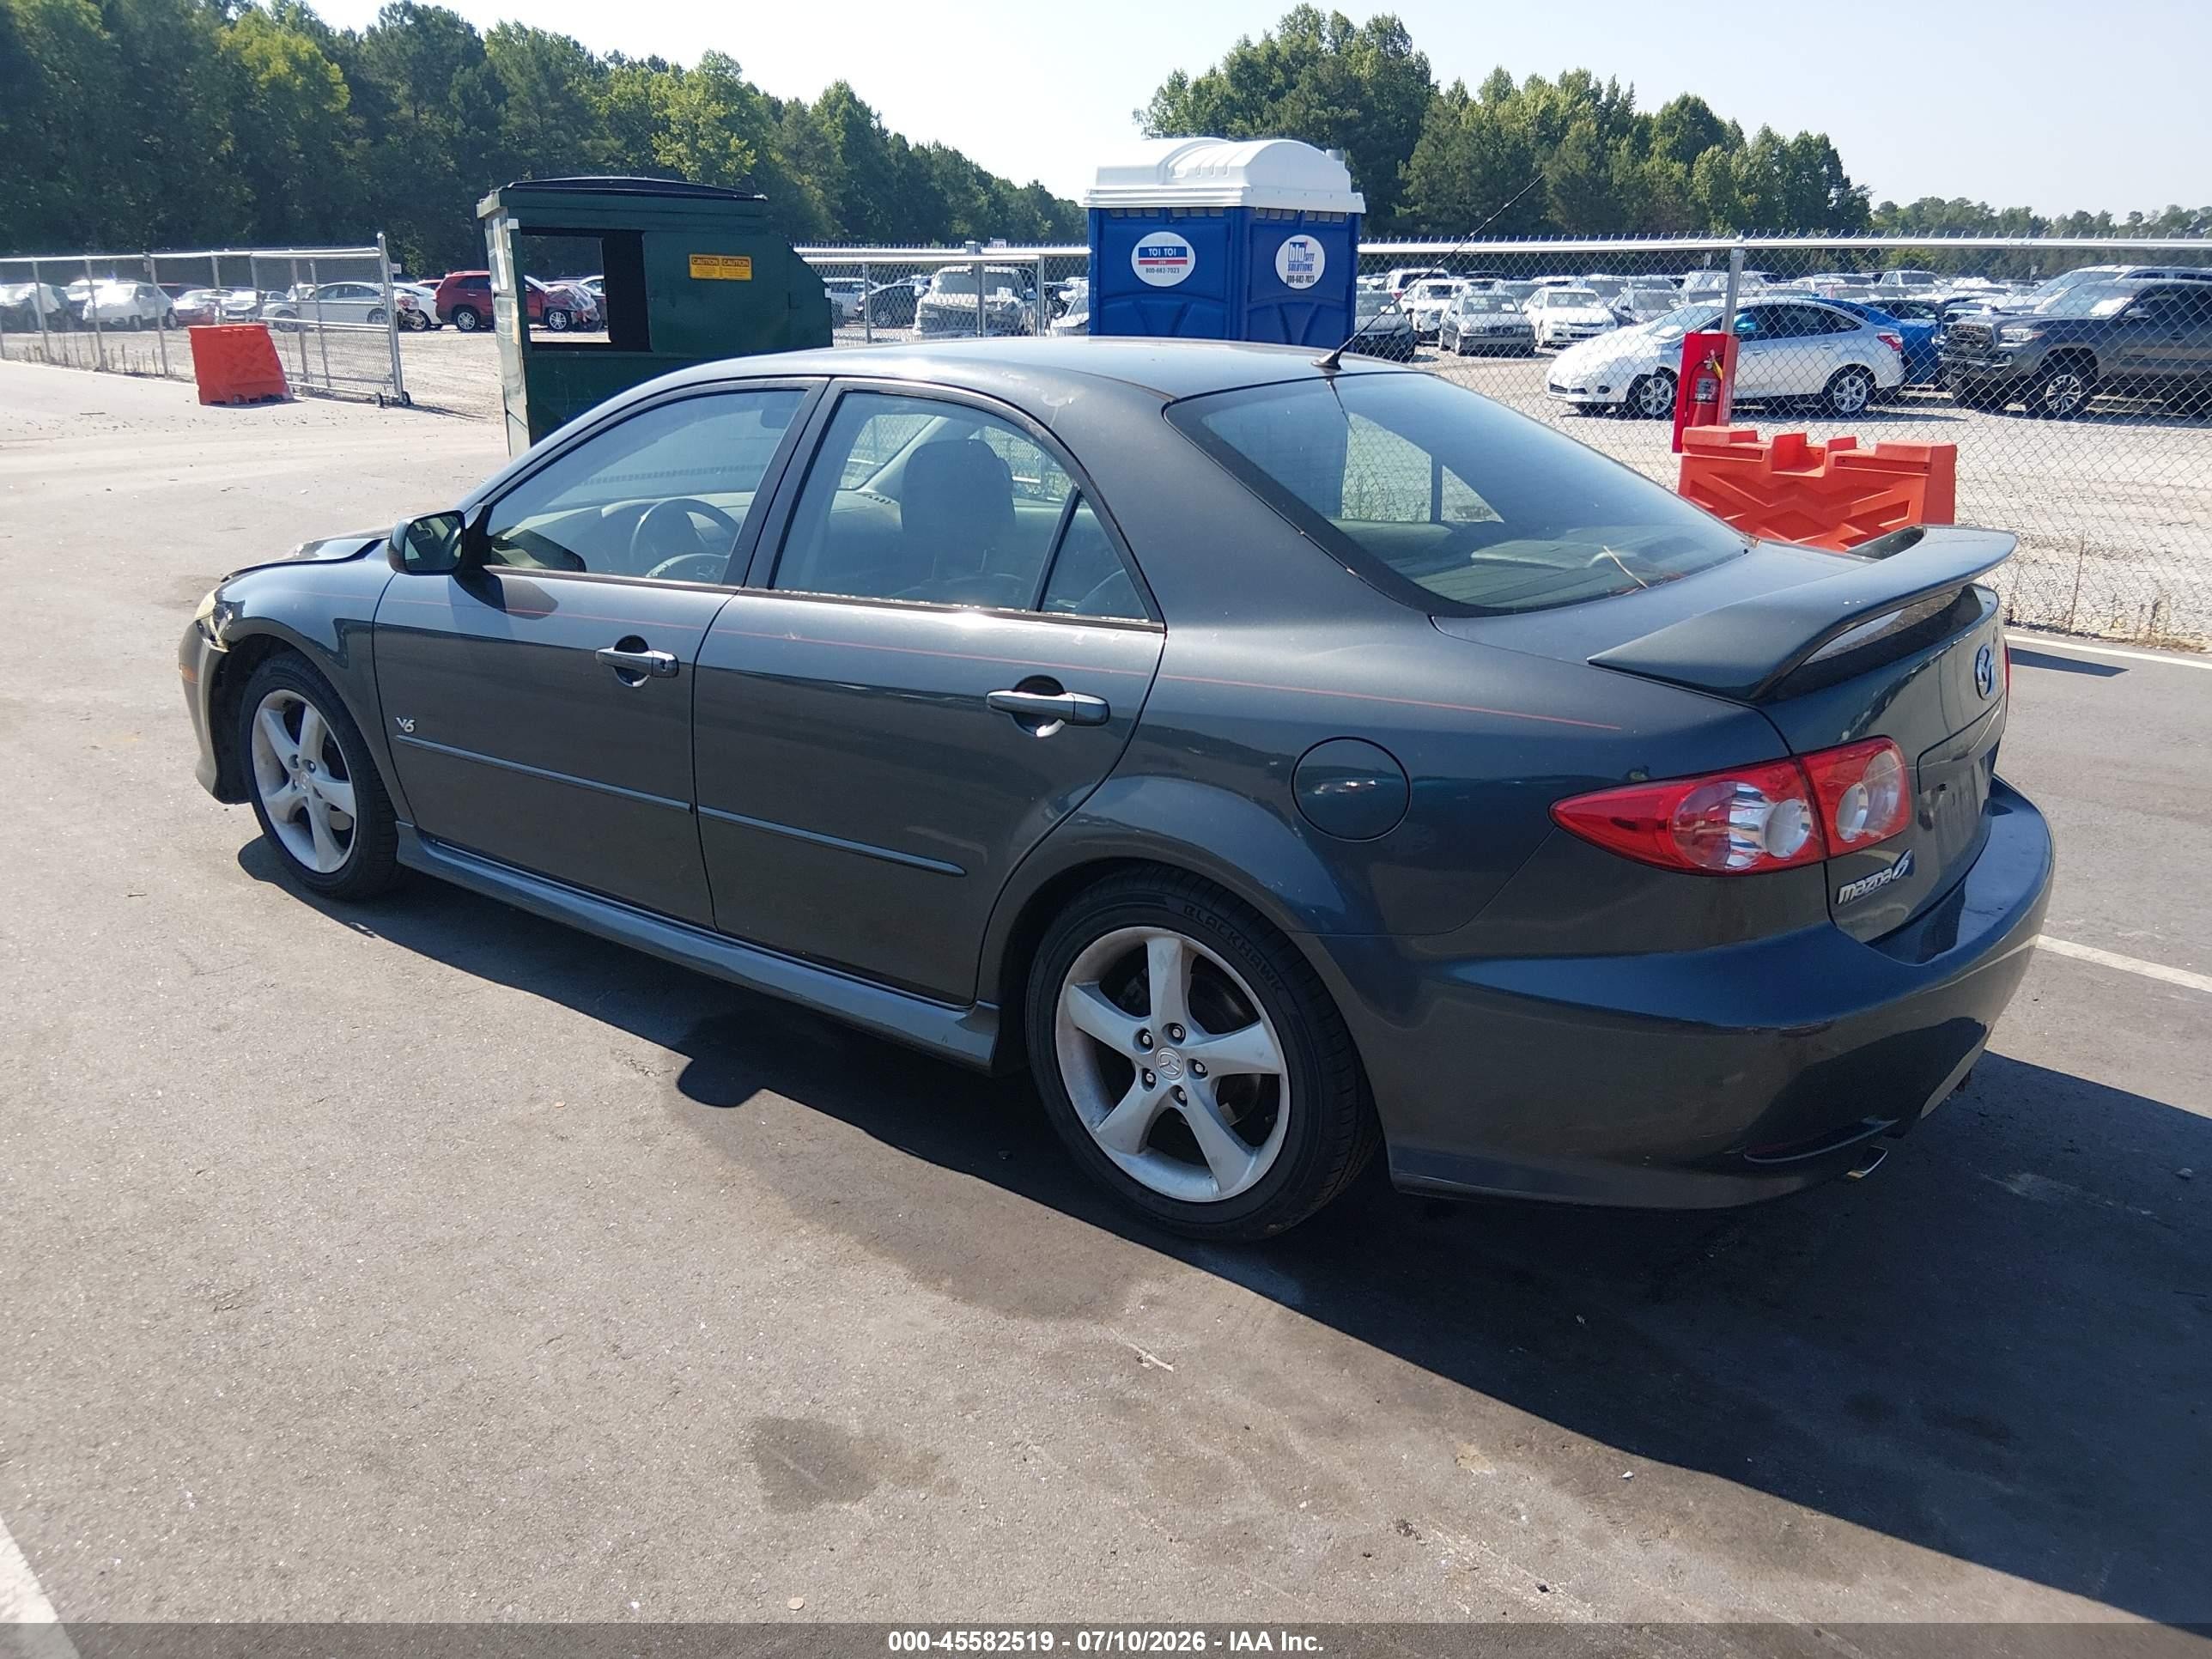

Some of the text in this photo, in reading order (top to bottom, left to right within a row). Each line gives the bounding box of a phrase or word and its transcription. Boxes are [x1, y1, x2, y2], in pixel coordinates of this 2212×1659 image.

[1148, 248, 1176, 257] TOI TOI
[395, 717, 416, 733] V6
